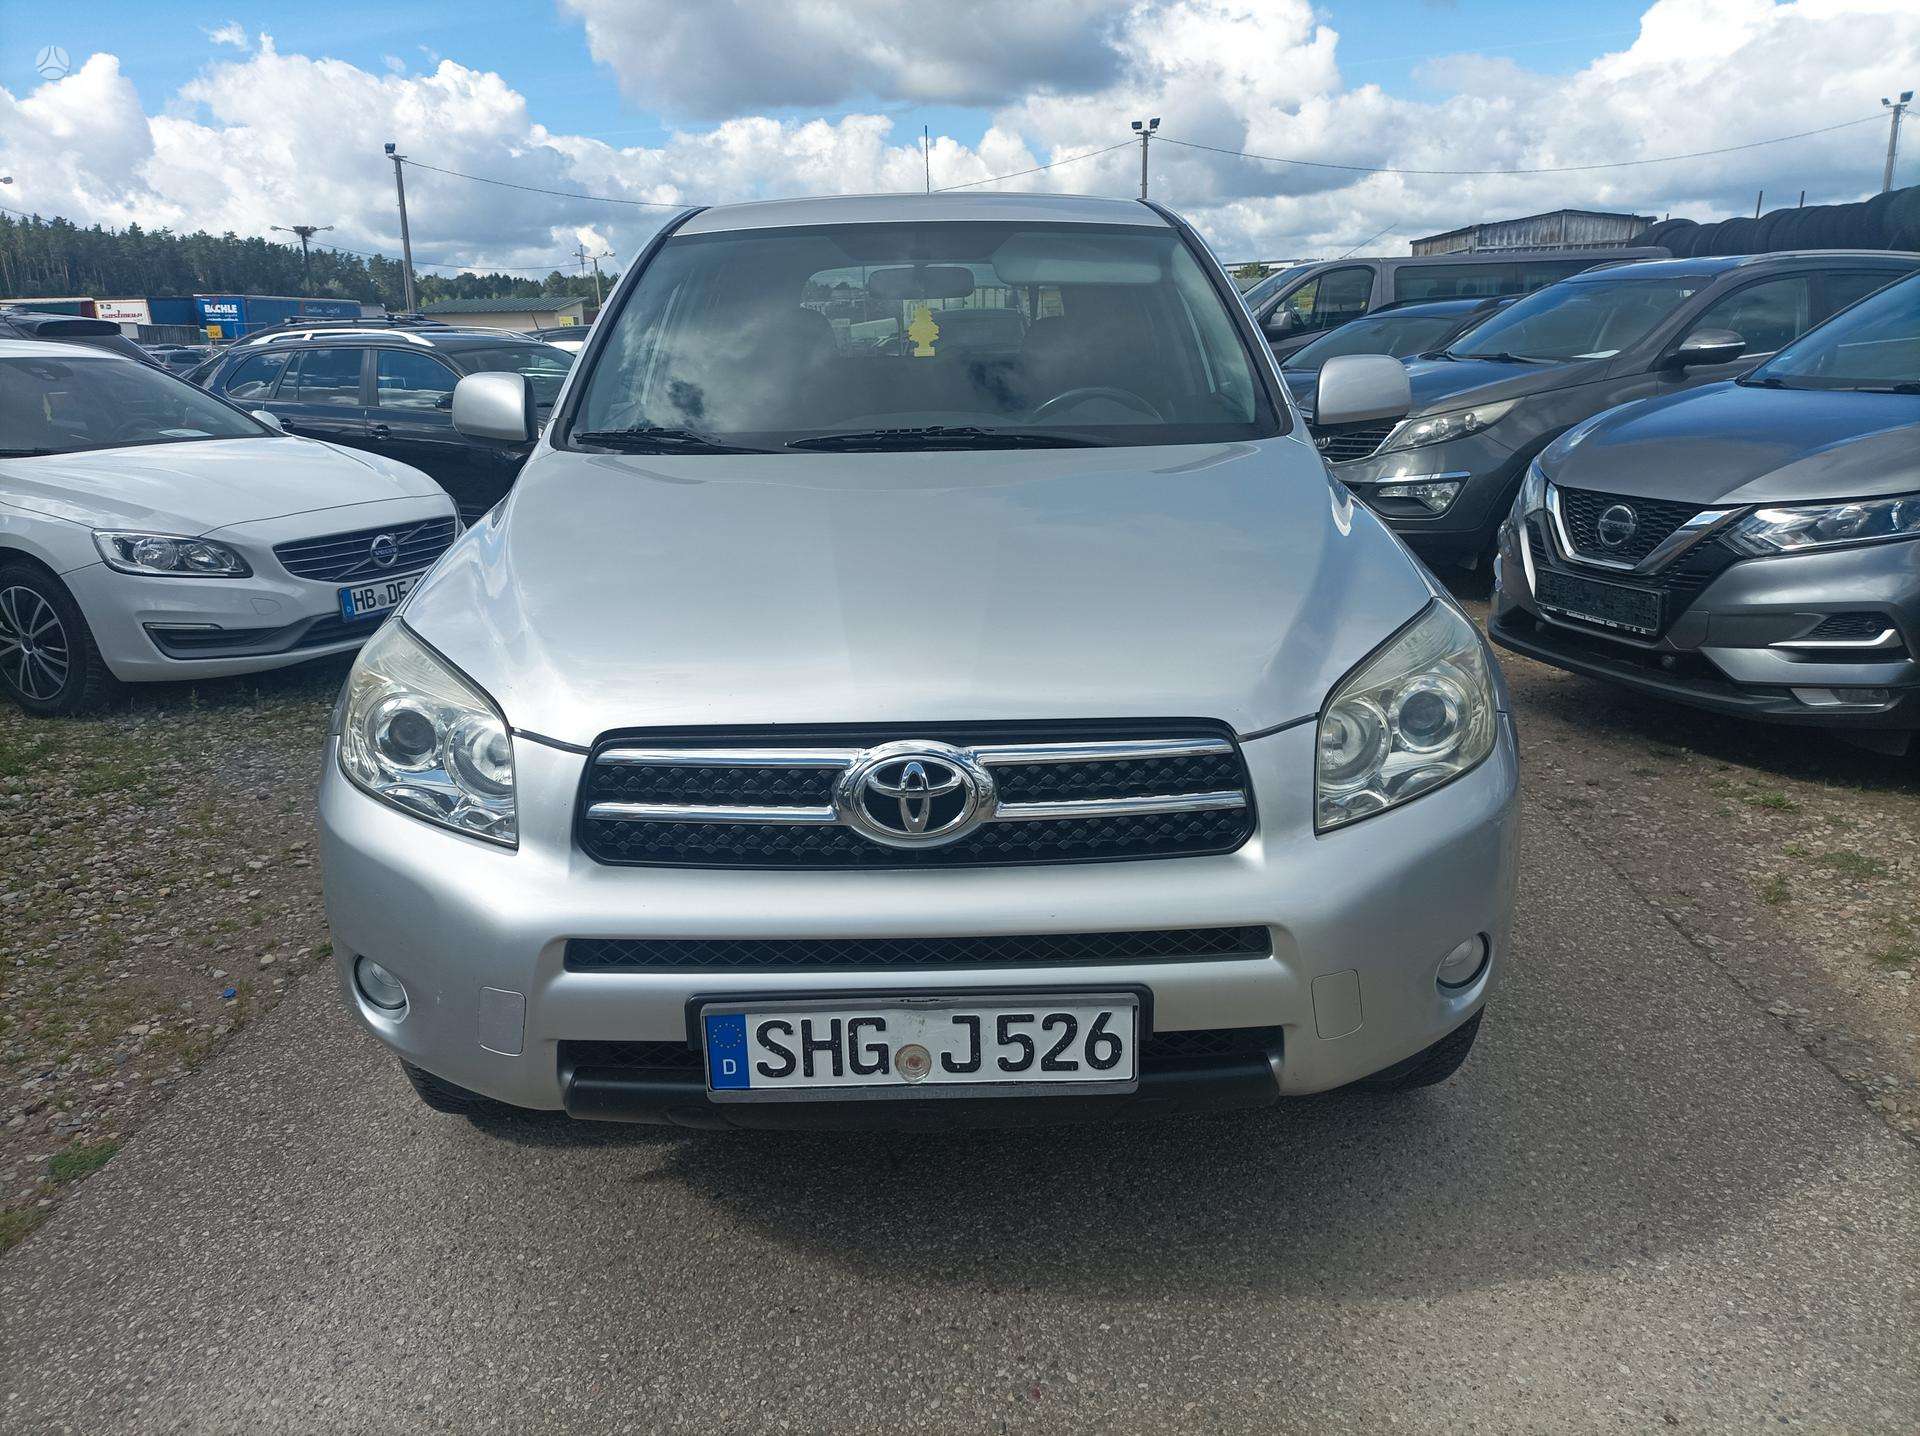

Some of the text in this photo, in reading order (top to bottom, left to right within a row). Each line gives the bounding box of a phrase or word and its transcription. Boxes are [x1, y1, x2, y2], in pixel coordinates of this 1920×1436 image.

[353, 589, 376, 611] HB
[756, 1016, 890, 1078] SHG
[723, 1059, 737, 1075] D
